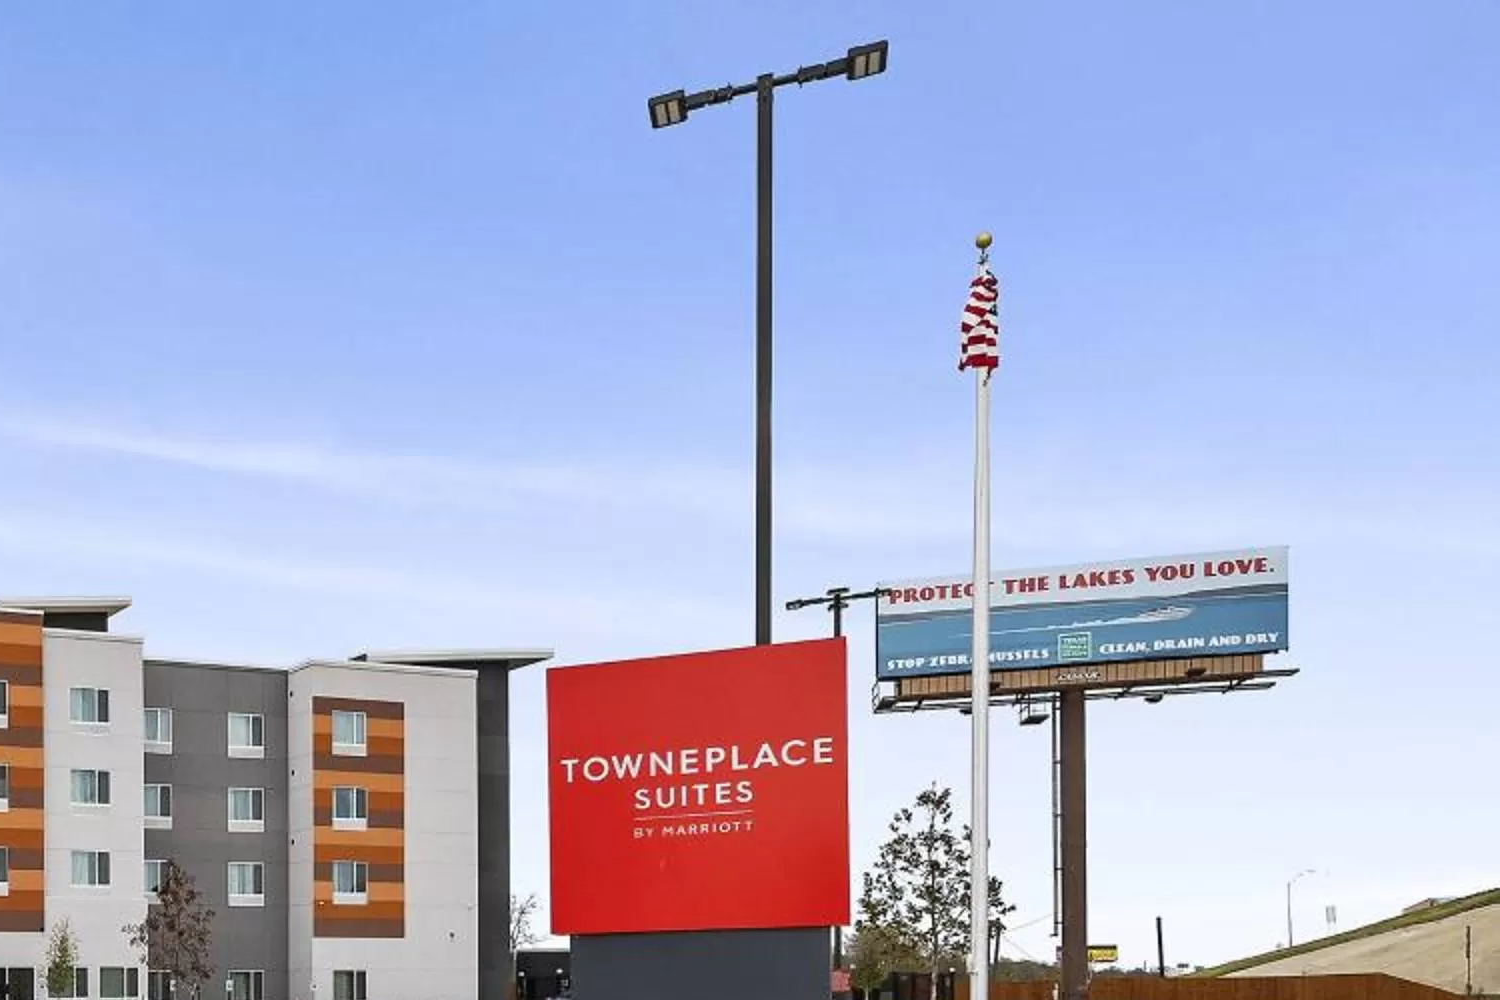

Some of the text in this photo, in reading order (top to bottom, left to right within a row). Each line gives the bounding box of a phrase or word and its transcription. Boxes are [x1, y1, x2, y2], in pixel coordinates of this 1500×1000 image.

[889, 557, 1274, 604] PROTEC THE LAKES YOU LOVE.
[887, 657, 925, 670] STOP
[929, 655, 974, 667] ZEBR
[1100, 642, 1150, 654] CLEAN,
[1154, 637, 1205, 650] DRAIN
[1209, 634, 1242, 647] AND
[1246, 632, 1278, 644] DRY
[560, 737, 833, 783] TOWNEPLACE
[634, 780, 753, 809] SUITES
[633, 820, 753, 839] BY MARRIOTT
